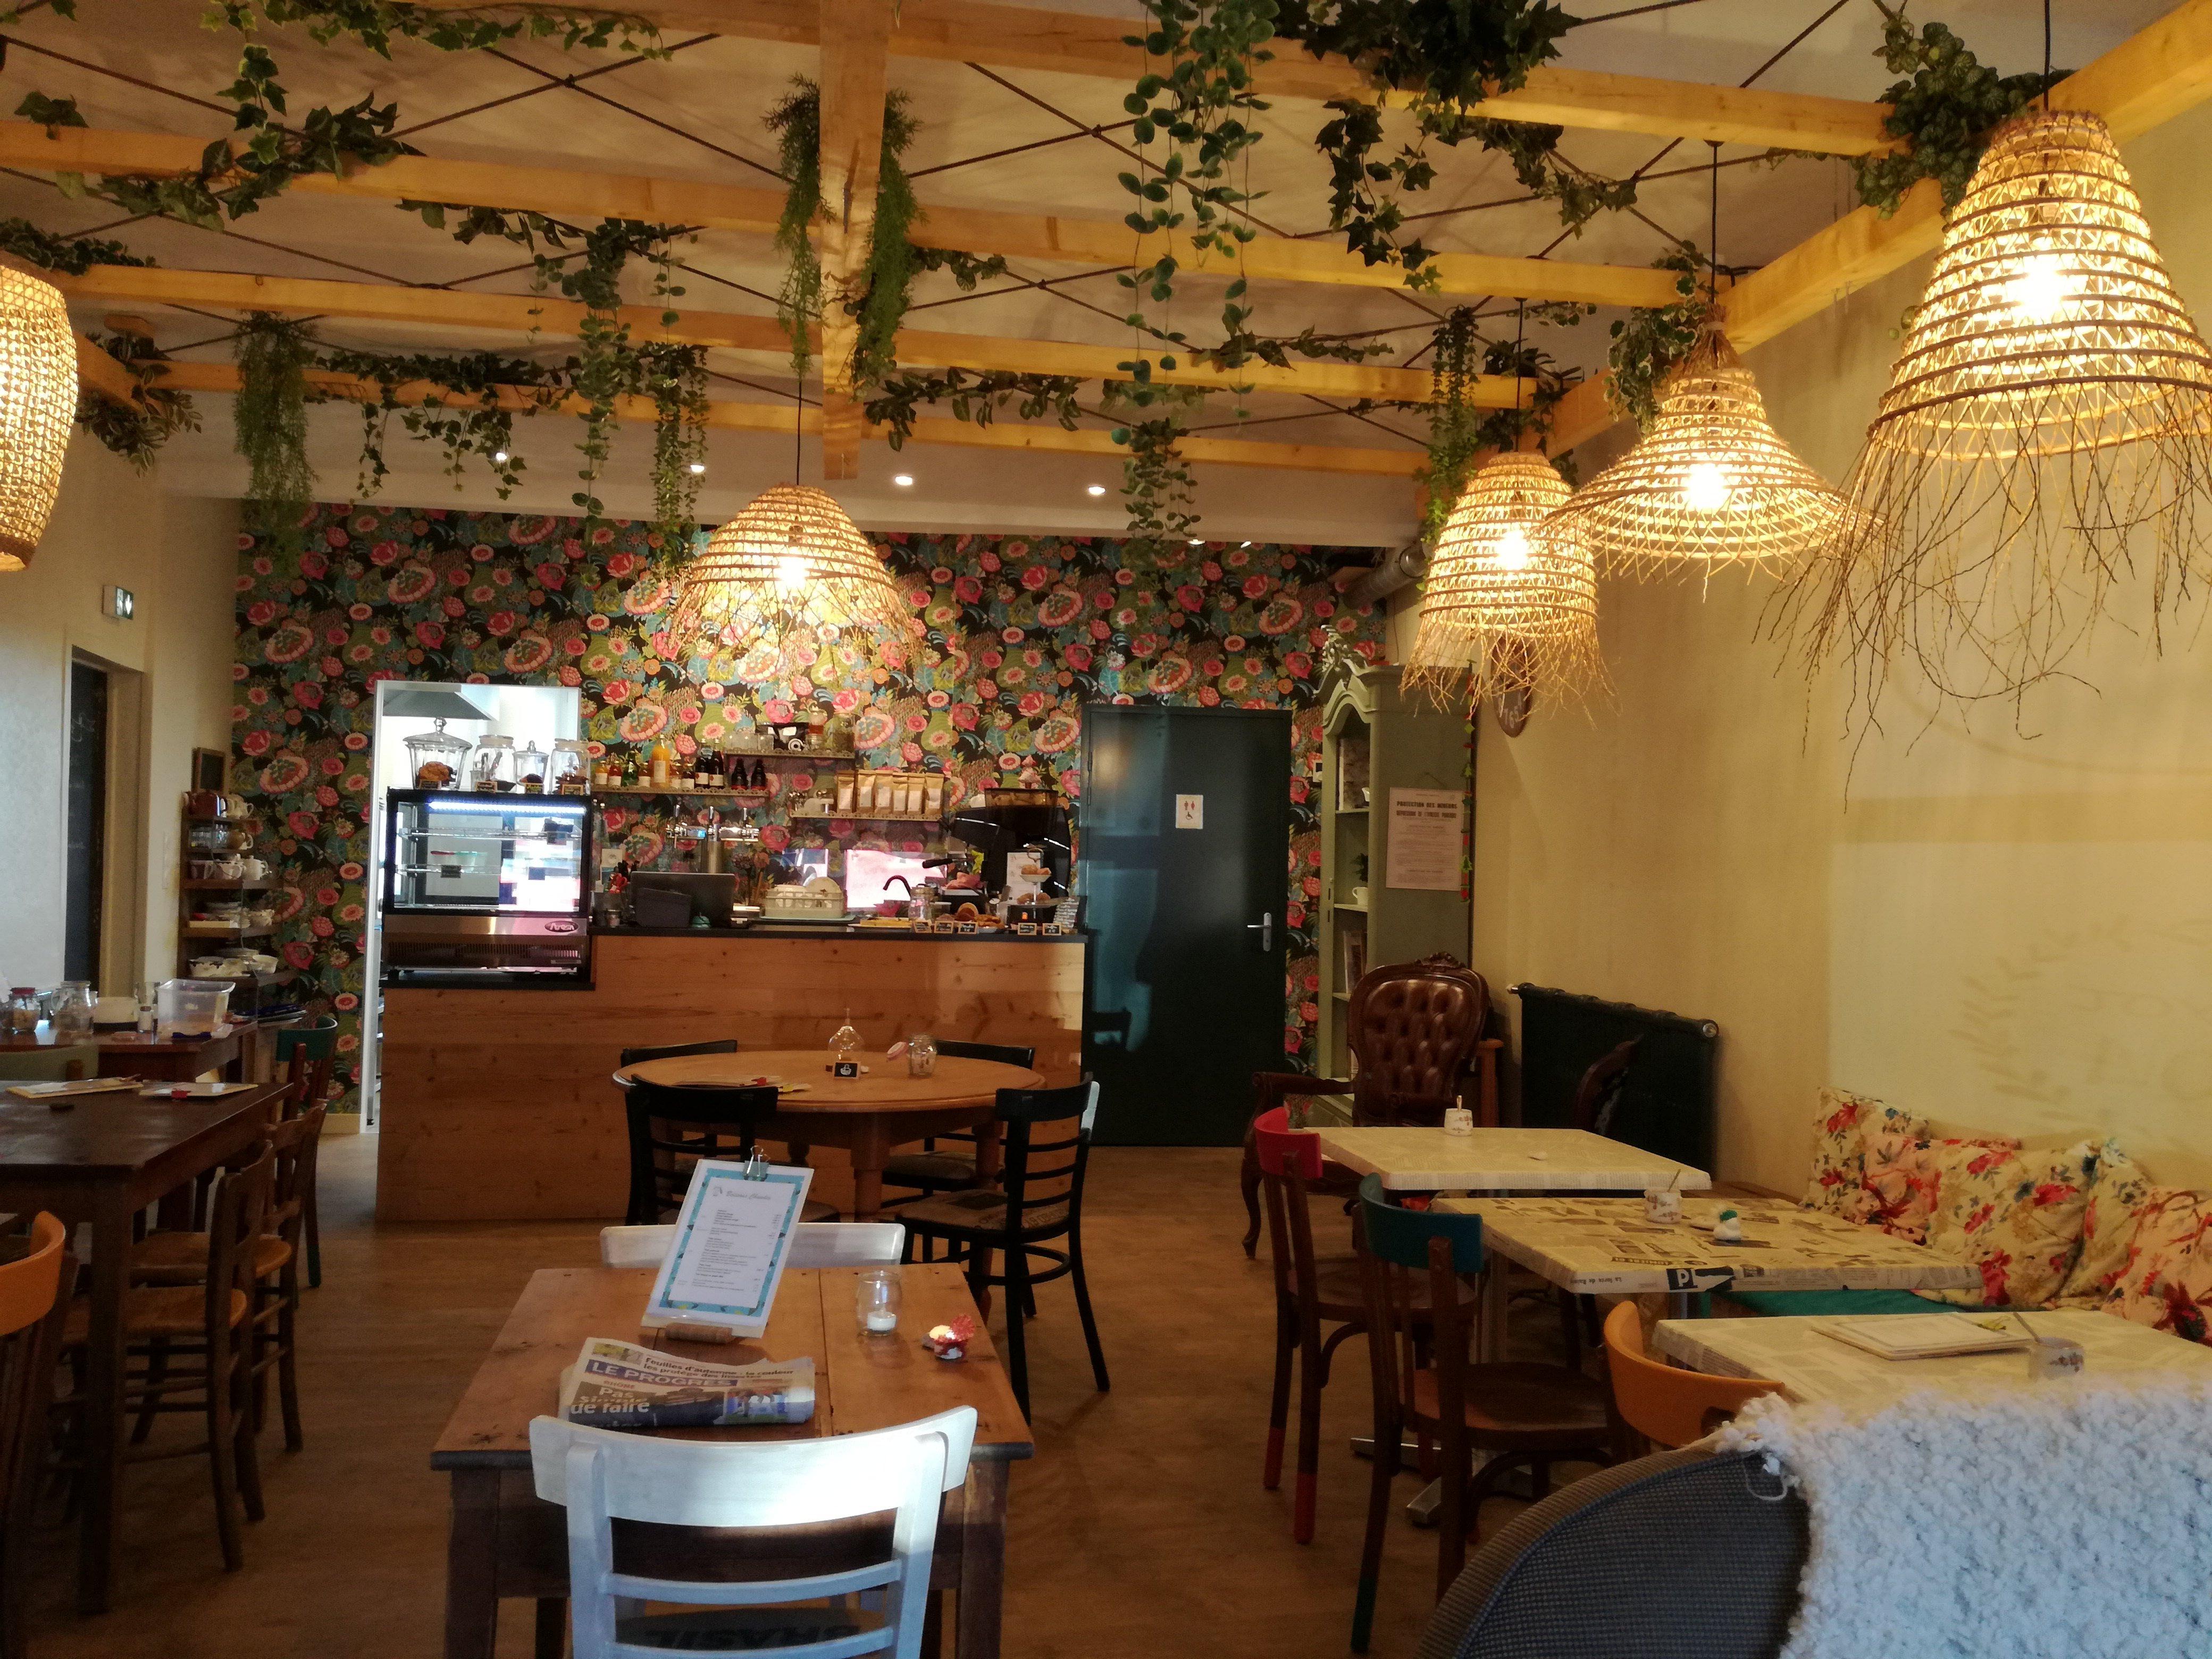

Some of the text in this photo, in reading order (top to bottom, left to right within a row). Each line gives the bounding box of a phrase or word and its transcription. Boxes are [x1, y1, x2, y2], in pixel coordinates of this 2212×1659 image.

[592, 1362, 619, 1376] LE
[599, 1387, 634, 1398] Pas
[570, 1402, 650, 1414] de faire
